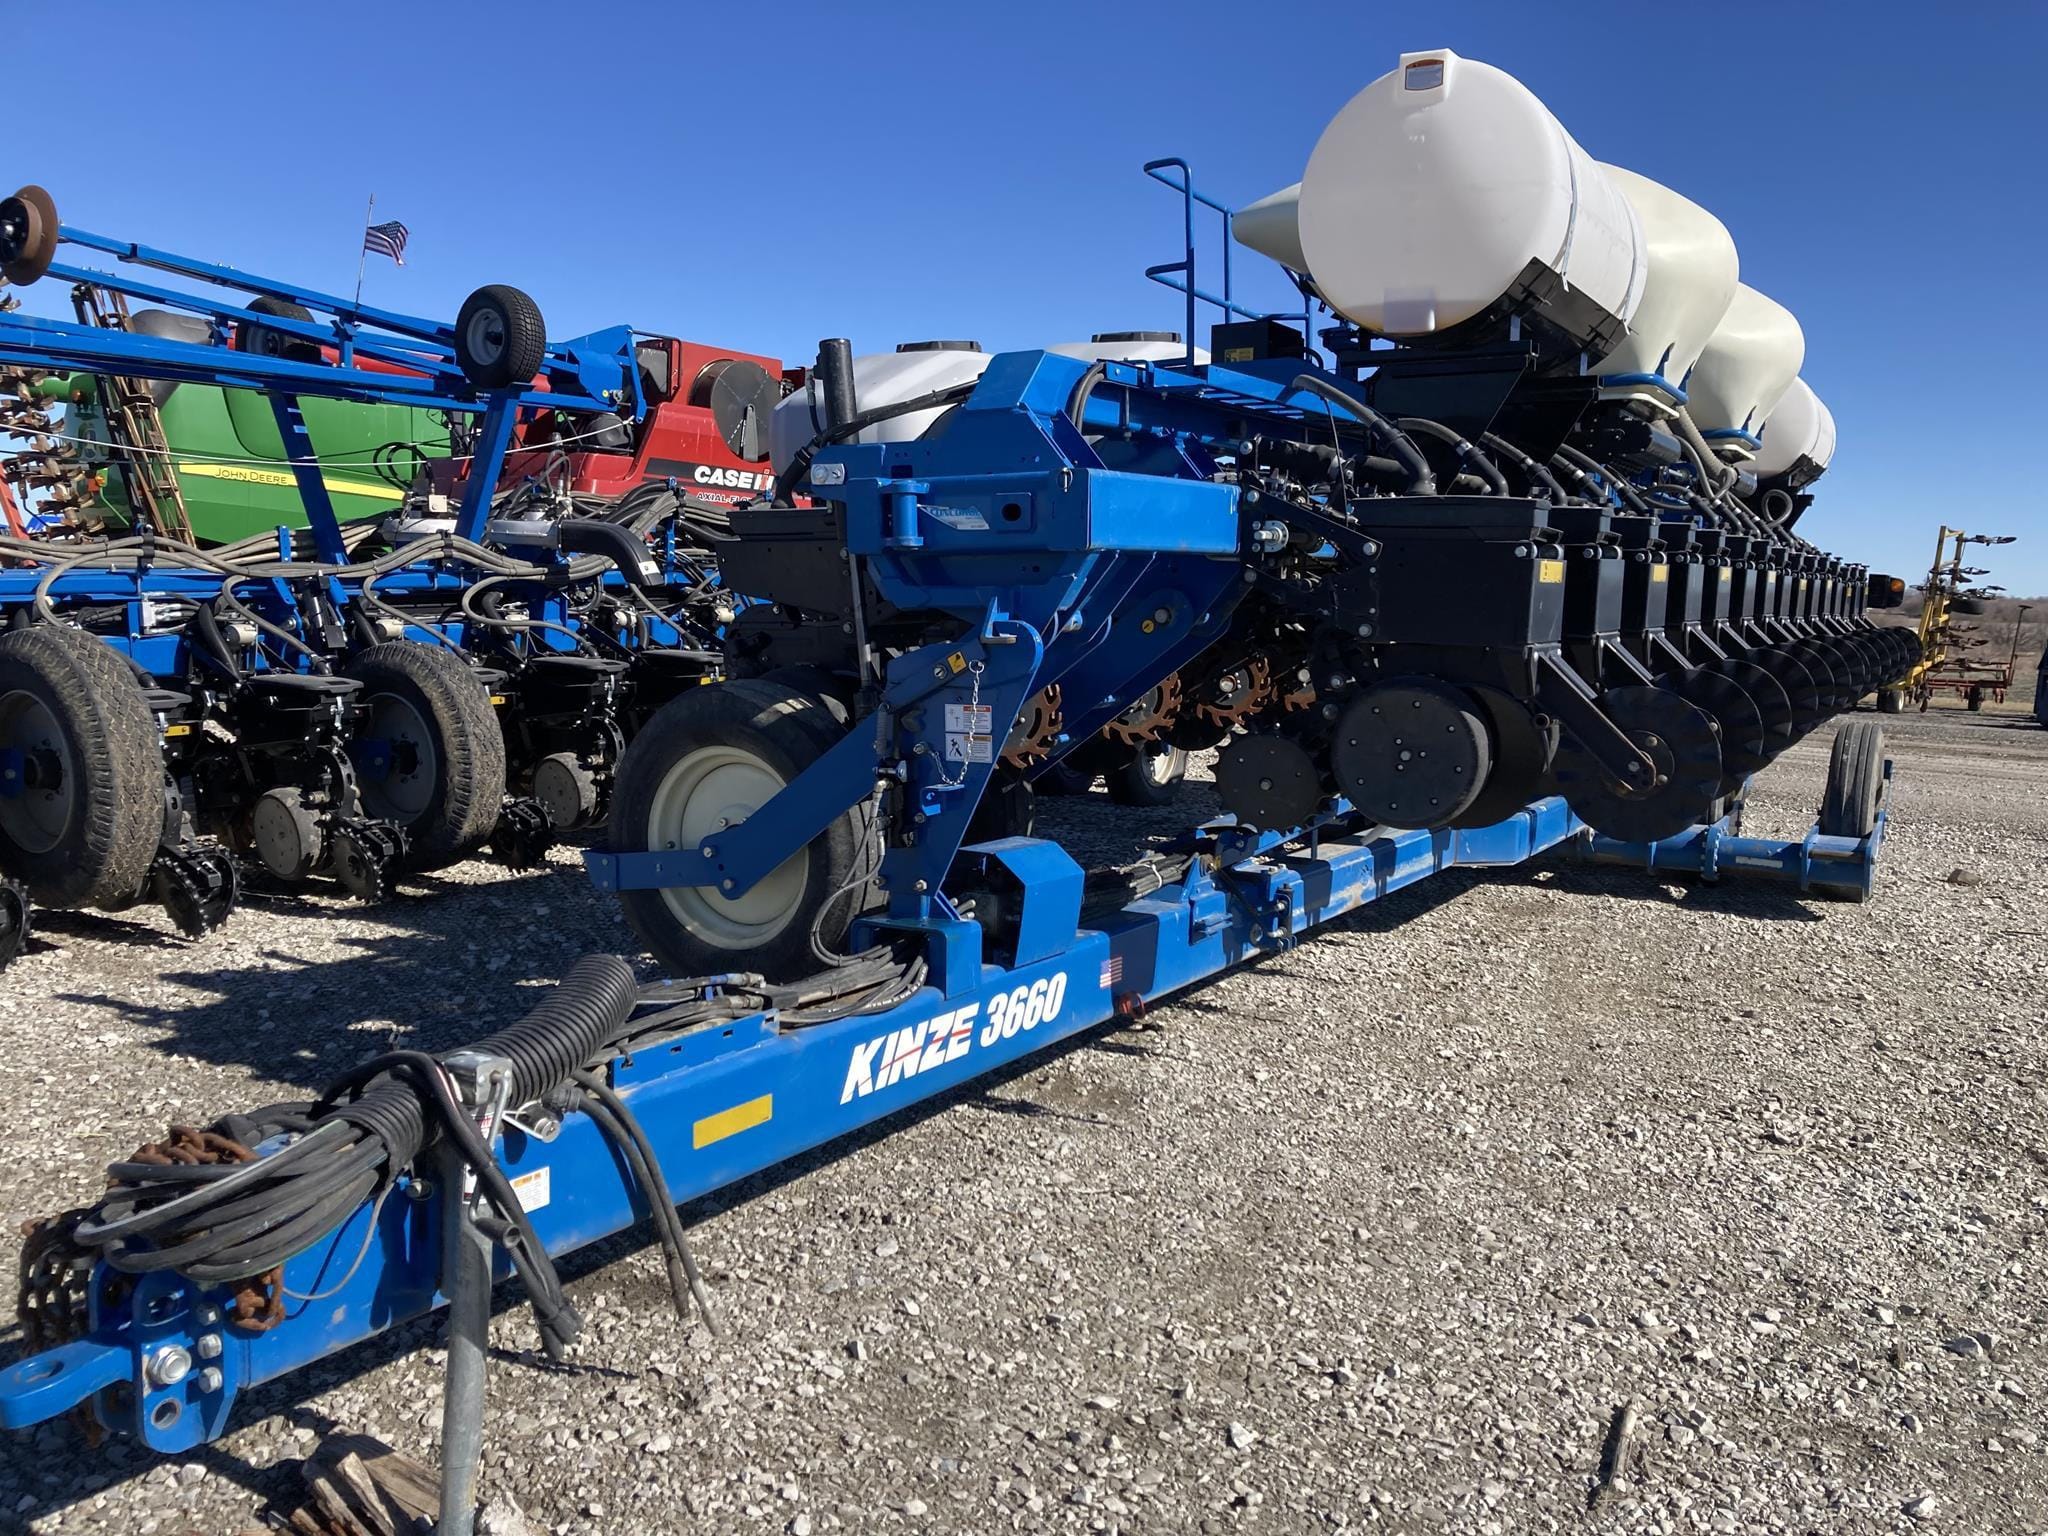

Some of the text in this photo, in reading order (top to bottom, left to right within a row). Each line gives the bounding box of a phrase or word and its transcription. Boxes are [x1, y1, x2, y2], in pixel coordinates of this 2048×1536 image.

[215, 468, 288, 484] JOHN DEERE
[694, 465, 754, 490] CASE
[839, 1002, 980, 1105] KINZE
[980, 971, 1068, 1048] 3660
